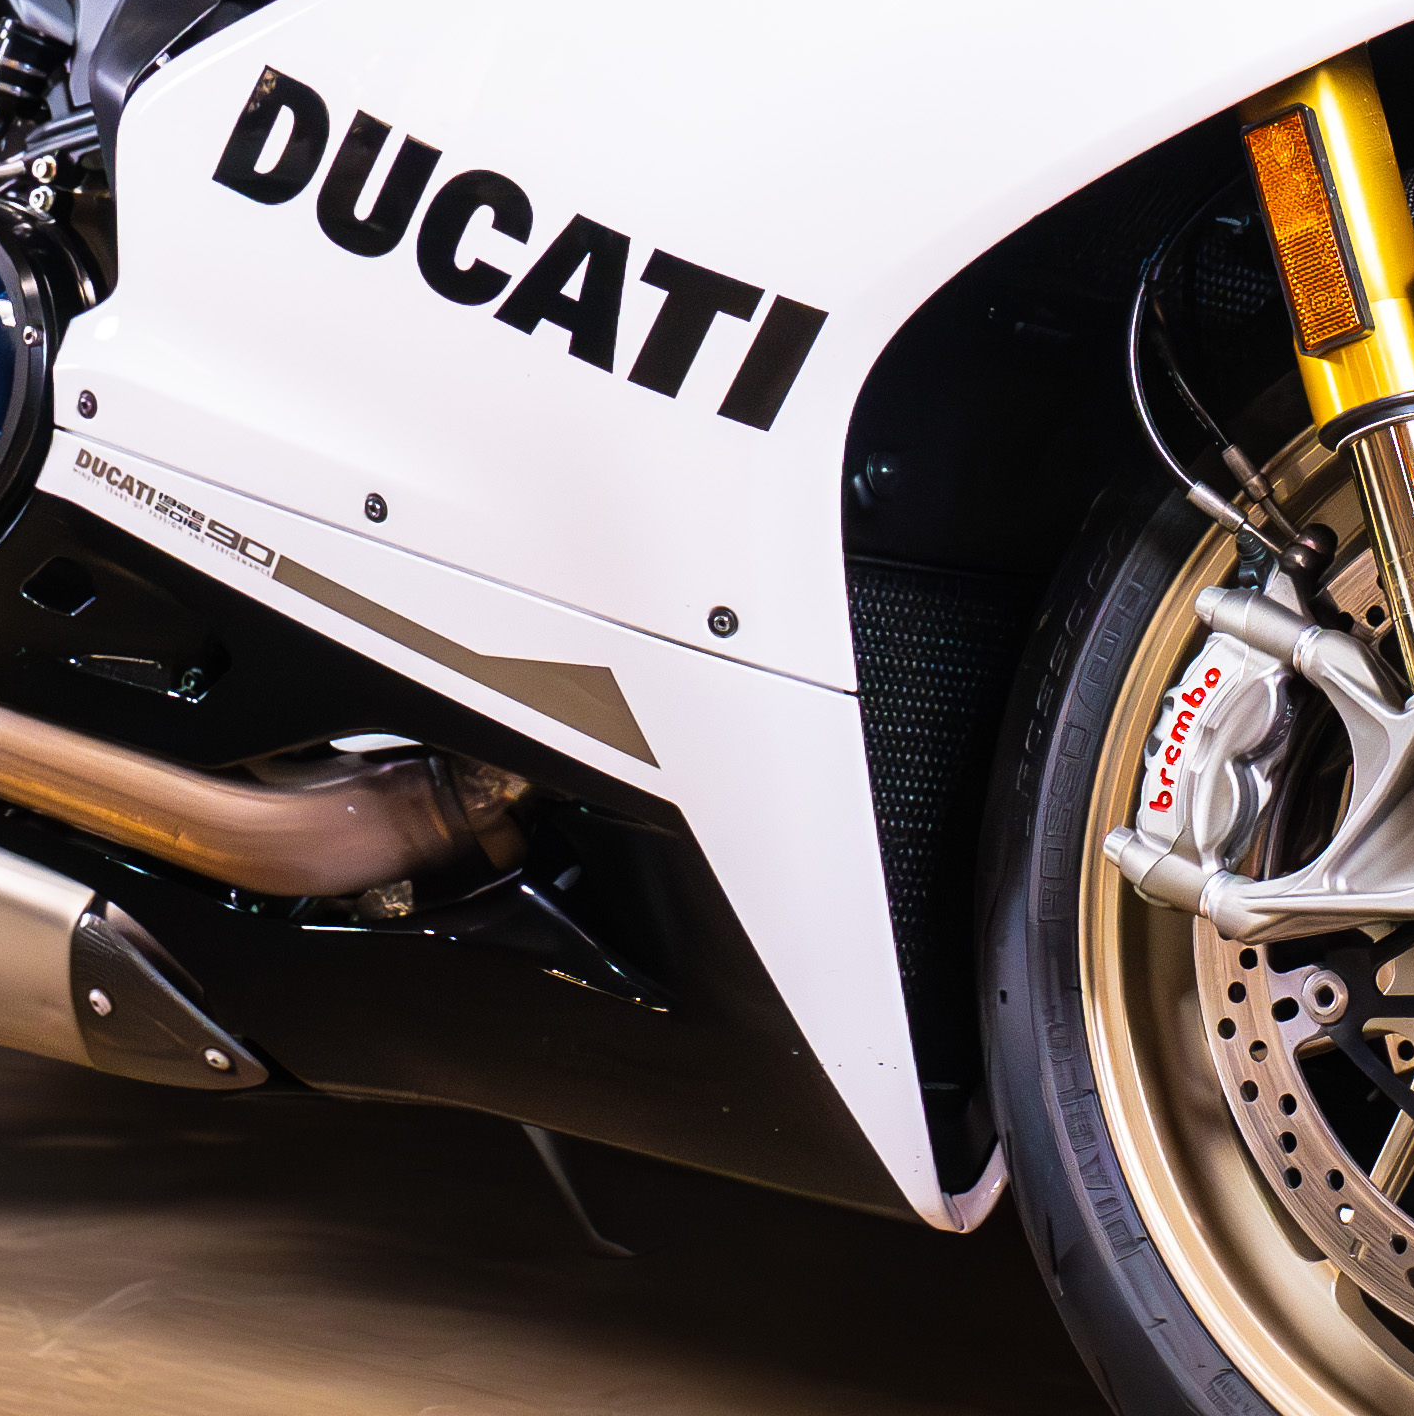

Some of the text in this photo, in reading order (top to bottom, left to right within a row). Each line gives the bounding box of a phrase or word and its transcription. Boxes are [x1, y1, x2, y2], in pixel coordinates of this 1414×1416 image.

[211, 64, 830, 432] DUCATI
[74, 447, 156, 506] DUCATI
[154, 502, 203, 533] 2016
[204, 518, 276, 568] 90
[1149, 666, 1222, 813] brembo
